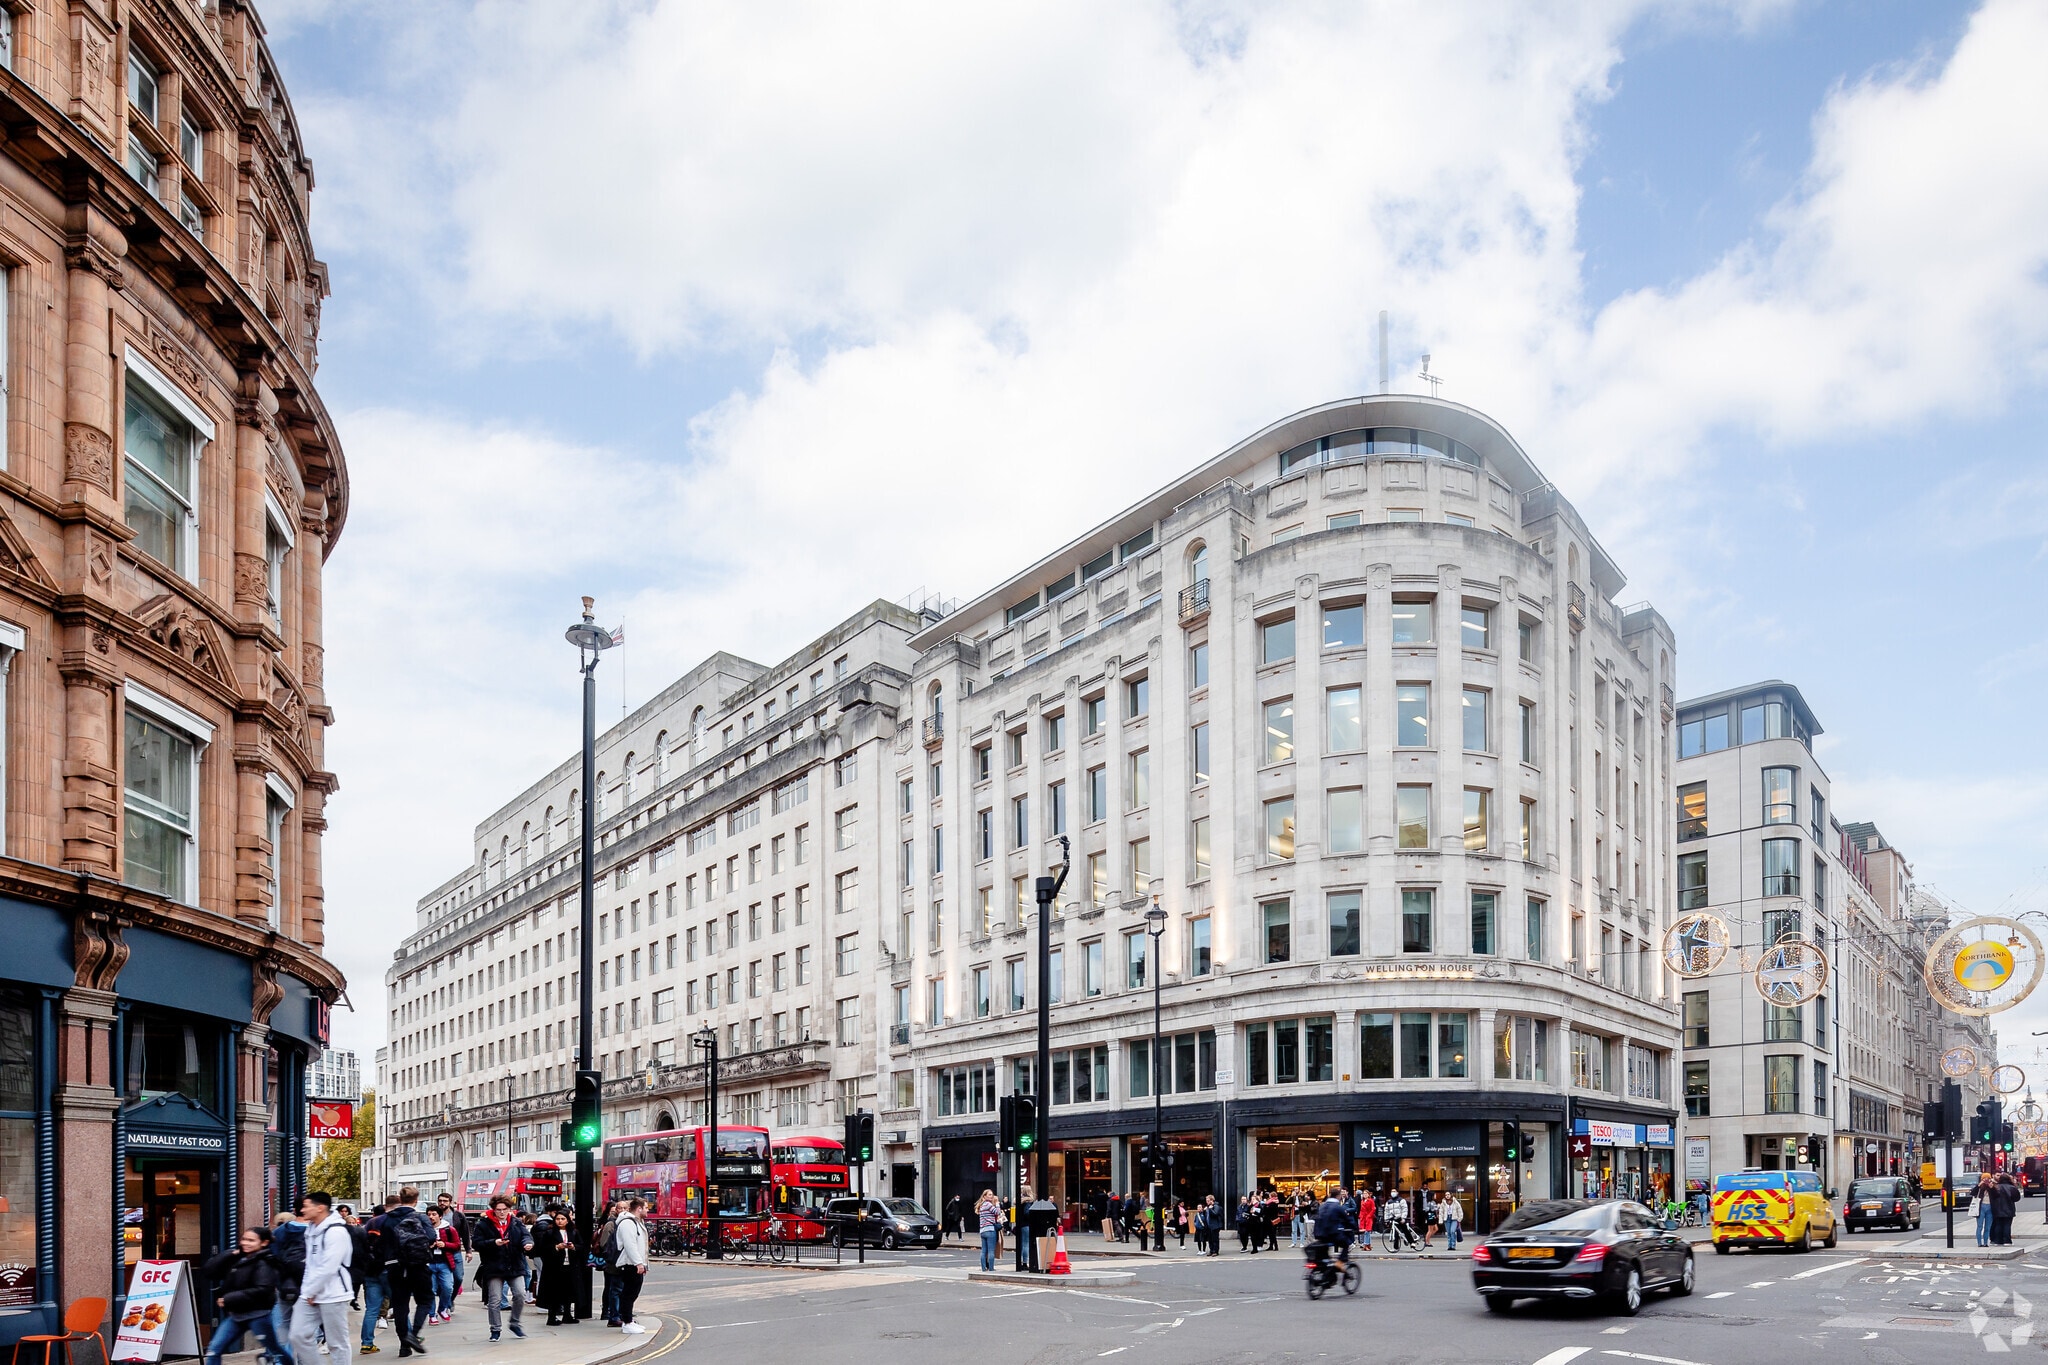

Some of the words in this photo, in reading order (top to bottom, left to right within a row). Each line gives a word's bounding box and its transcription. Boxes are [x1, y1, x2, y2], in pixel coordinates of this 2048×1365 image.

[1960, 951, 2007, 961] NORTHBANK
[1365, 964, 1435, 973] WELLINGTON
[1440, 964, 1473, 973] HOUSE
[313, 1126, 349, 1137] LEON
[1592, 1125, 1612, 1137] TESCO
[1613, 1127, 1632, 1139] express
[128, 1134, 177, 1145] NATURALLY
[179, 1137, 197, 1146] FAST
[198, 1138, 222, 1147] FOOD
[751, 1165, 762, 1174] 188
[831, 1174, 840, 1182] 176
[1727, 1203, 1769, 1220] HSS
[13, 1262, 29, 1271] WIFI
[141, 1270, 172, 1284] GFC
